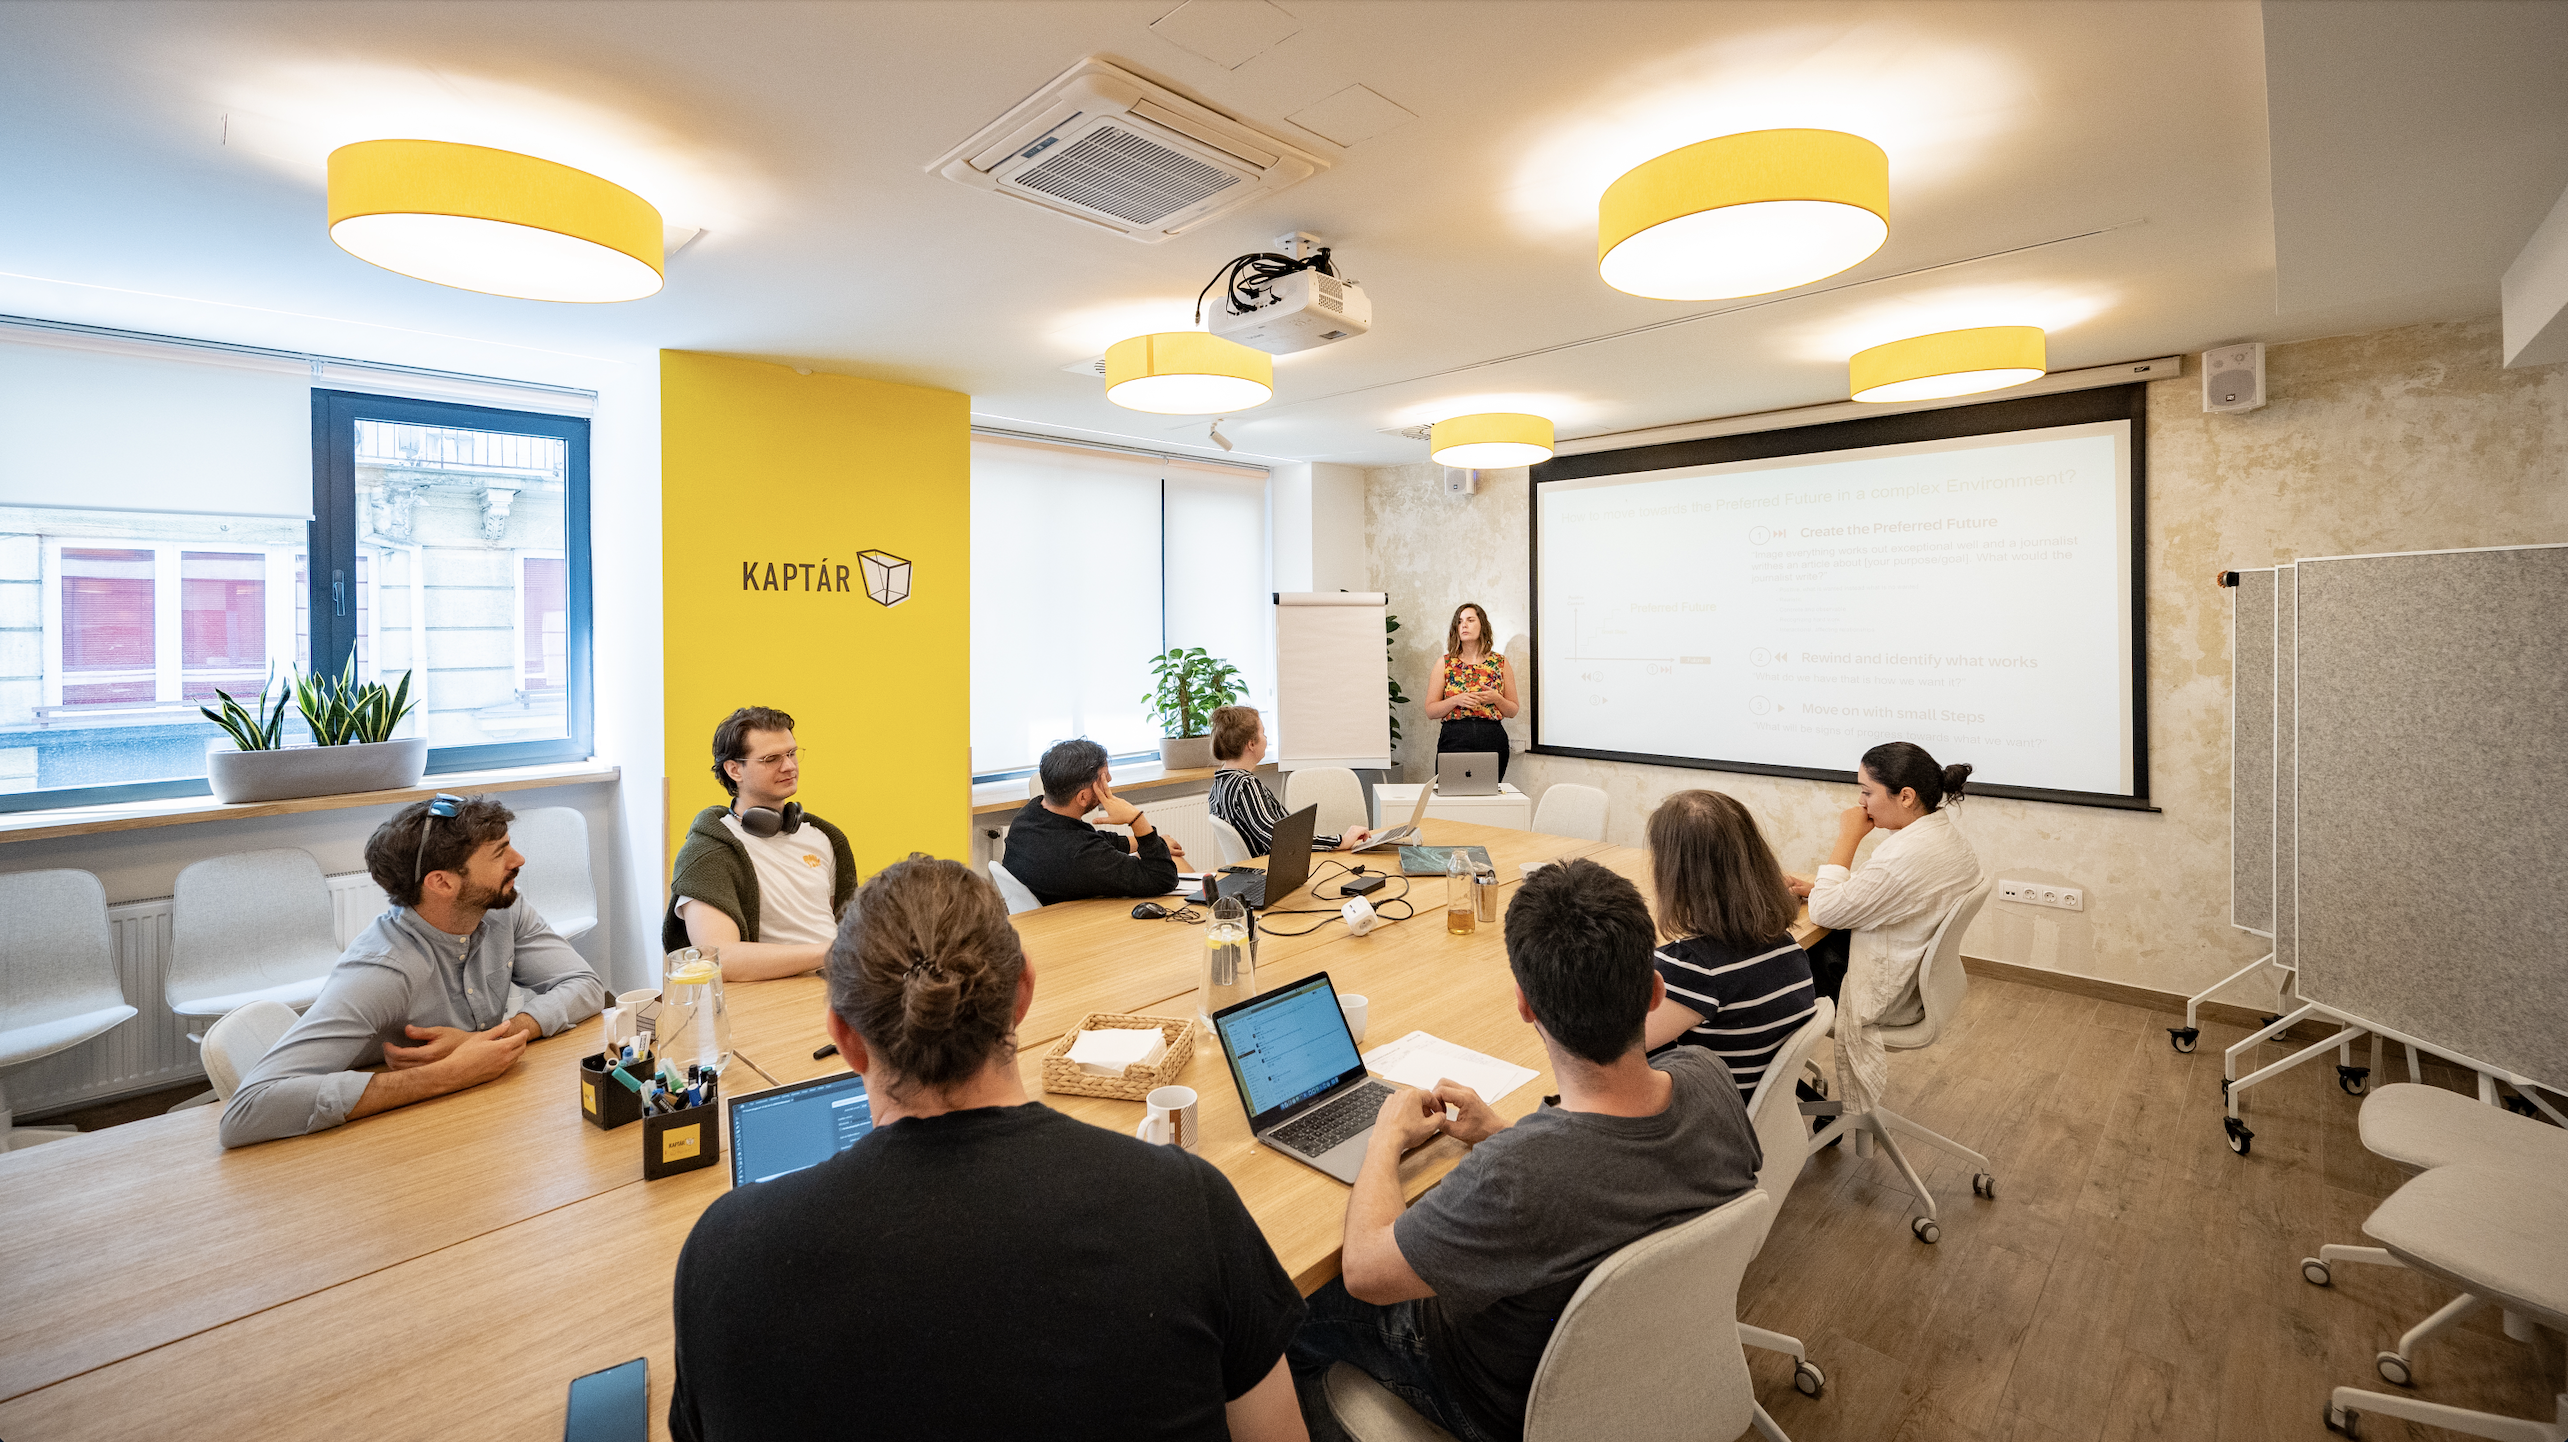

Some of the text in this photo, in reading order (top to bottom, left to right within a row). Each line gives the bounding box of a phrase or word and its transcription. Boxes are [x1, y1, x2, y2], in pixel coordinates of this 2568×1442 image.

[1561, 469, 2077, 523] How to move towards the Preferred Future in a complex Environment?
[1800, 525, 1844, 538] Create
[1847, 524, 1870, 535] the
[1873, 519, 1942, 534] Preferred
[1946, 517, 1998, 530] Future
[1786, 547, 1835, 558] everything
[1838, 545, 1868, 556] works
[1871, 545, 1888, 554] out
[1891, 541, 1953, 554] exceptional
[1956, 540, 1979, 550] well
[1982, 539, 2005, 549] and
[2009, 540, 2017, 548] a
[2020, 535, 2078, 550] journalist
[1751, 561, 1784, 571] writhes
[1801, 559, 1831, 569] article
[1833, 558, 1862, 568] about
[1976, 552, 2008, 563] What
[2011, 550, 2048, 561] would
[2052, 550, 2073, 560] the
[743, 558, 850, 592] KAPTÁR
[1751, 573, 1793, 584] journalist
[1630, 601, 1717, 613] Preferred Future
[1802, 652, 1851, 664] Rewind
[1855, 653, 1882, 664] and
[1885, 653, 1942, 669] identify
[1945, 654, 1984, 667] what
[1988, 655, 2038, 668] works
[1782, 673, 1794, 682] do
[1813, 674, 1838, 683] have
[1840, 674, 1860, 684] that
[1862, 675, 1871, 684] is
[1874, 675, 1896, 684] how
[1899, 678, 1915, 686] we
[1918, 678, 1945, 687] want
[1802, 703, 1839, 715] Move
[1841, 706, 1859, 716] on
[1863, 706, 1893, 718] with
[1897, 708, 1937, 721] small
[1940, 710, 1986, 725] Steps
[1782, 723, 1798, 732] will
[1800, 724, 1812, 733] be
[1815, 725, 1841, 736] signs
[1844, 727, 1854, 736] of
[1857, 729, 1903, 740] progress
[1906, 731, 1950, 743] towards
[1953, 734, 1981, 745] what
[1984, 737, 2002, 746] we
